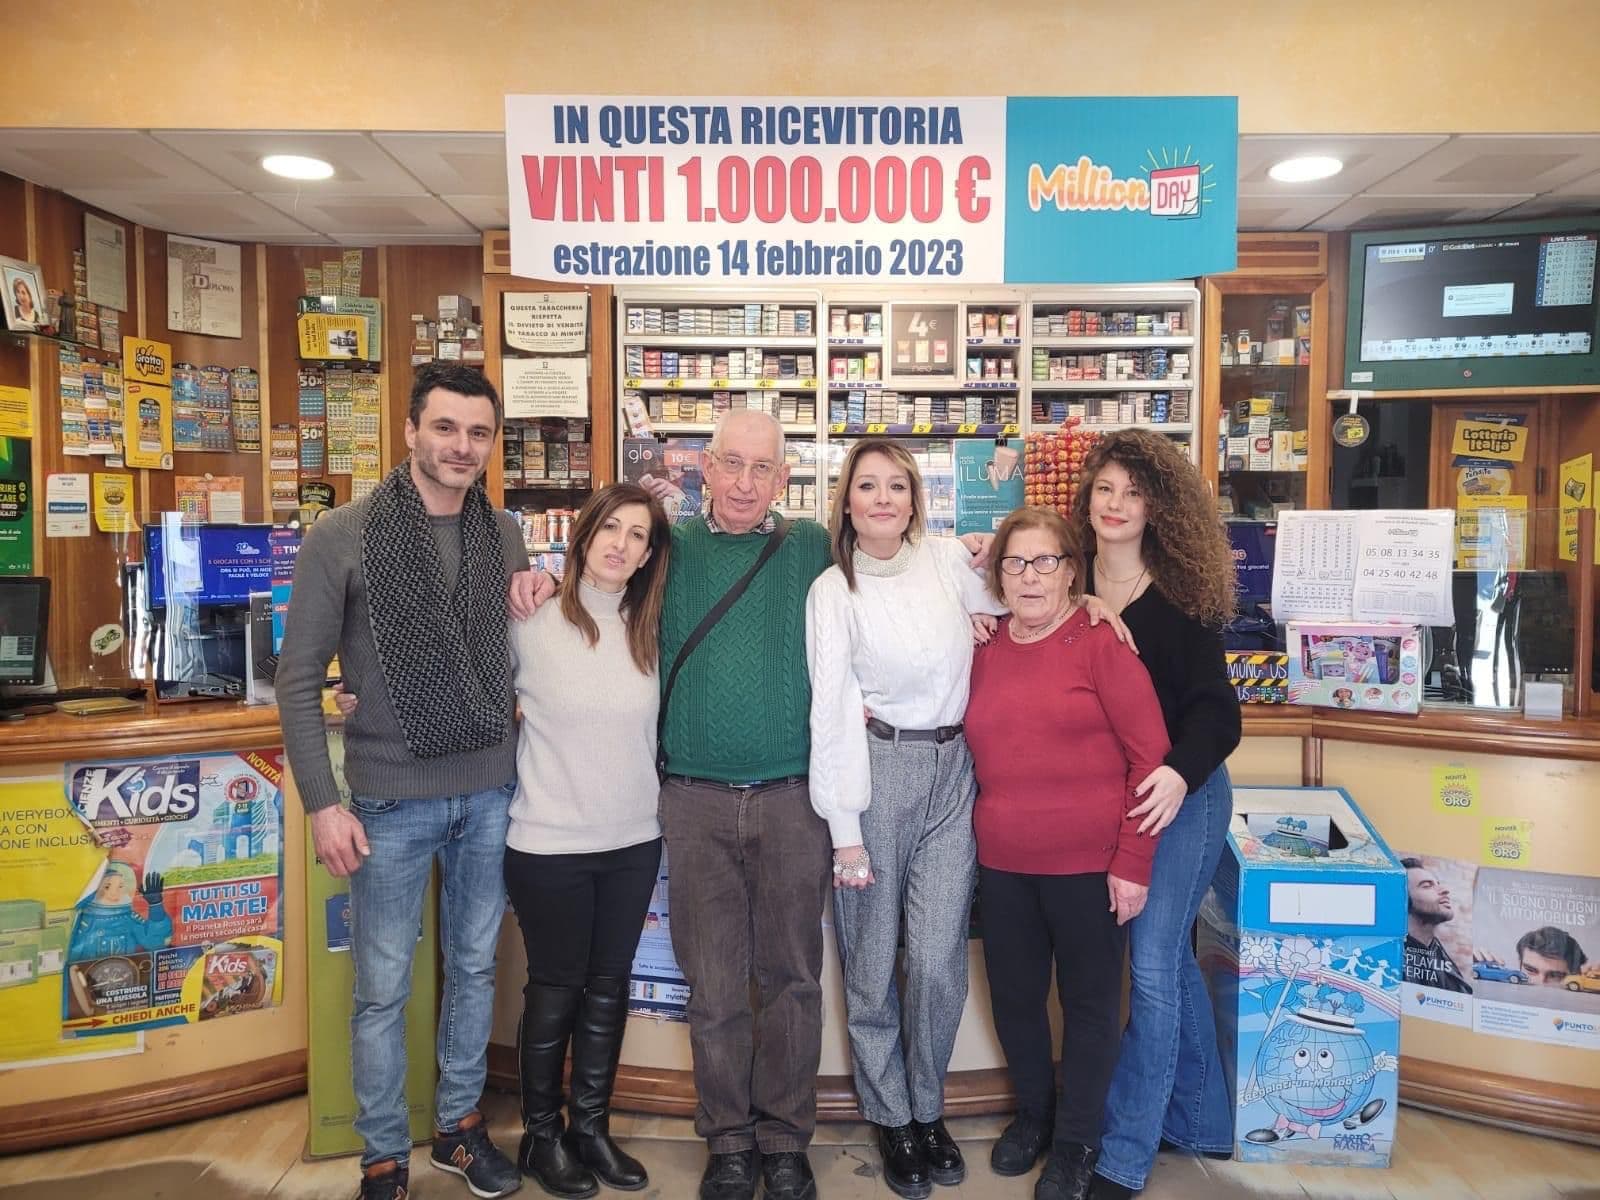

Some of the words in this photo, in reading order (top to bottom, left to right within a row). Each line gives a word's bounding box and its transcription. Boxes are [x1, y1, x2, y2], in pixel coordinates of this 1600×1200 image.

[553, 105, 589, 144] IN
[599, 105, 733, 148] QUESTA
[741, 106, 963, 145] RICEVITORIA
[521, 155, 664, 222] VINTI
[677, 155, 943, 224] 1.000.000
[954, 155, 992, 223] €
[1028, 155, 1150, 212] Million
[1157, 179, 1191, 209] DAY
[553, 240, 711, 276] estrazione
[717, 241, 749, 275] 14
[756, 238, 883, 276] febbraio
[889, 240, 963, 276] 2023
[136, 353, 161, 366] Gratta
[1464, 429, 1517, 441] Lotteria
[1469, 440, 1511, 452] Italia
[628, 444, 653, 464] glo
[960, 464, 1024, 482] ILUMA
[1366, 548, 1377, 557] 05
[1381, 549, 1393, 558] 08
[1398, 549, 1407, 557] 13
[1412, 550, 1424, 558] 34
[1428, 551, 1440, 559] 35
[1363, 568, 1375, 577] 04
[1378, 569, 1390, 578] 25
[1393, 570, 1406, 578] 40
[1409, 570, 1421, 579] 42
[1425, 571, 1438, 580] 48
[1270, 663, 1287, 679] US
[85, 766, 197, 820] Kids
[1443, 796, 1471, 808] ORO
[15, 823, 48, 835] CON
[1492, 847, 1521, 860] ORO
[189, 884, 237, 902] TUTTI
[239, 881, 261, 897] SU
[182, 896, 267, 923] MARTE!
[1488, 892, 1499, 905] IL
[1503, 893, 1546, 910] SOGNO
[1551, 898, 1562, 911] DI
[1567, 899, 1598, 915] OGNI
[1500, 906, 1586, 926] AUTOMOBILIS
[193, 922, 222, 931] Pianeta
[223, 920, 246, 929] Rosso
[189, 929, 215, 940] nostra
[215, 926, 247, 937] seconda
[208, 954, 248, 974] Kids
[96, 996, 113, 1005] UNA
[113, 991, 148, 1002] BUSSOLA
[105, 985, 148, 997] COSTRUISCI
[112, 1011, 152, 1025] CHIEDI
[156, 1003, 196, 1018] ANCHE
[1296, 1079, 1310, 1088] un
[1314, 1077, 1352, 1088] Mondo
[1334, 1133, 1372, 1145] CARTO
[1333, 1142, 1376, 1153] PLASTICA
